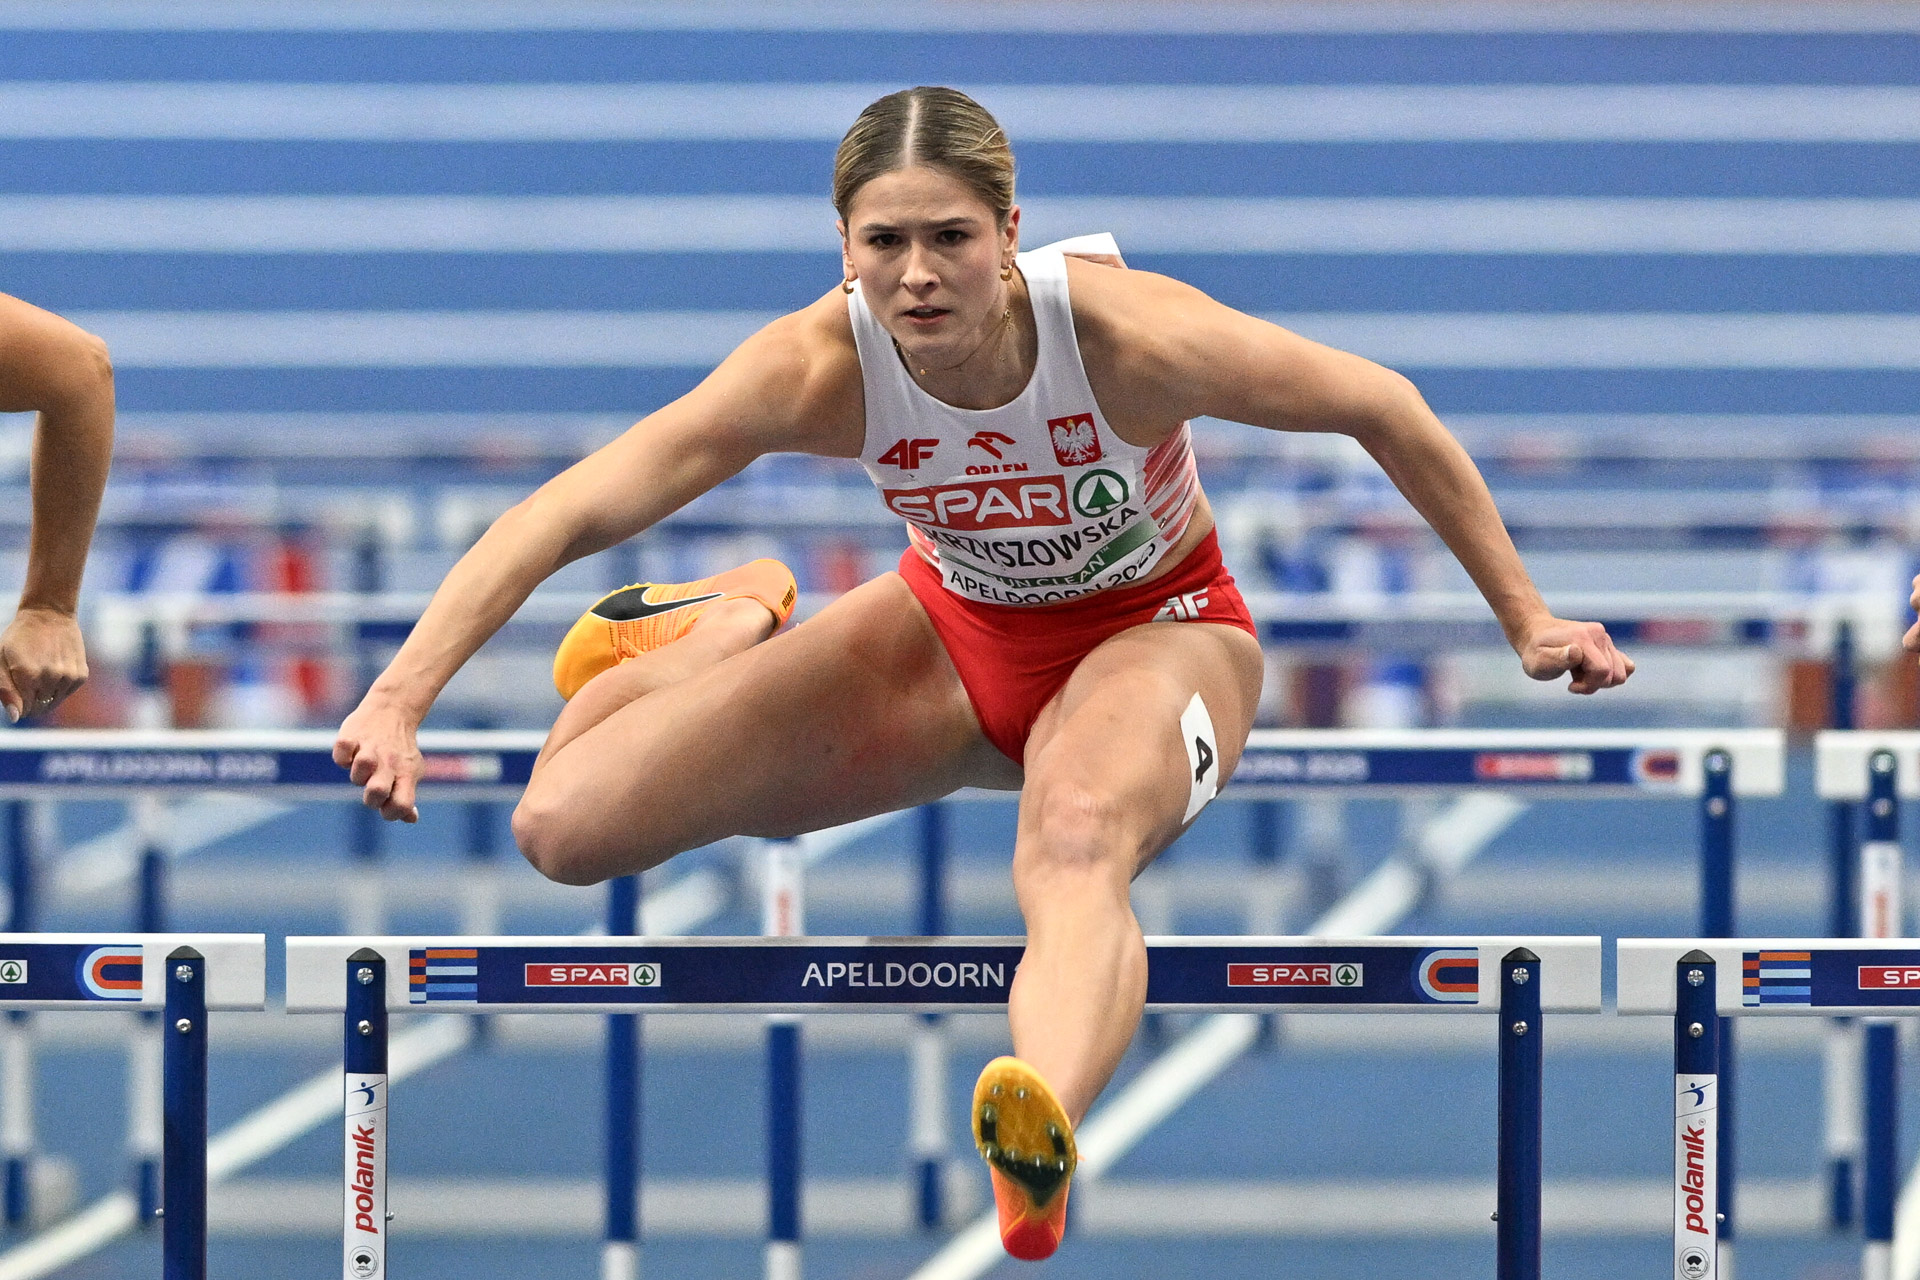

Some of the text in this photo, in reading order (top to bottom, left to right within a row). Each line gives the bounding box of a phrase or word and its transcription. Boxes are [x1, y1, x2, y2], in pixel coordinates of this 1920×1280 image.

[876, 438, 940, 470] 4F
[891, 484, 1065, 525] SPAR
[921, 507, 1139, 568] KRZYSZOWSKA
[550, 967, 628, 982] SPAR
[801, 962, 1004, 987] APELDOORN
[1252, 967, 1329, 982] SPAR
[351, 1124, 379, 1235] polanik
[1681, 1124, 1710, 1235] polanik
